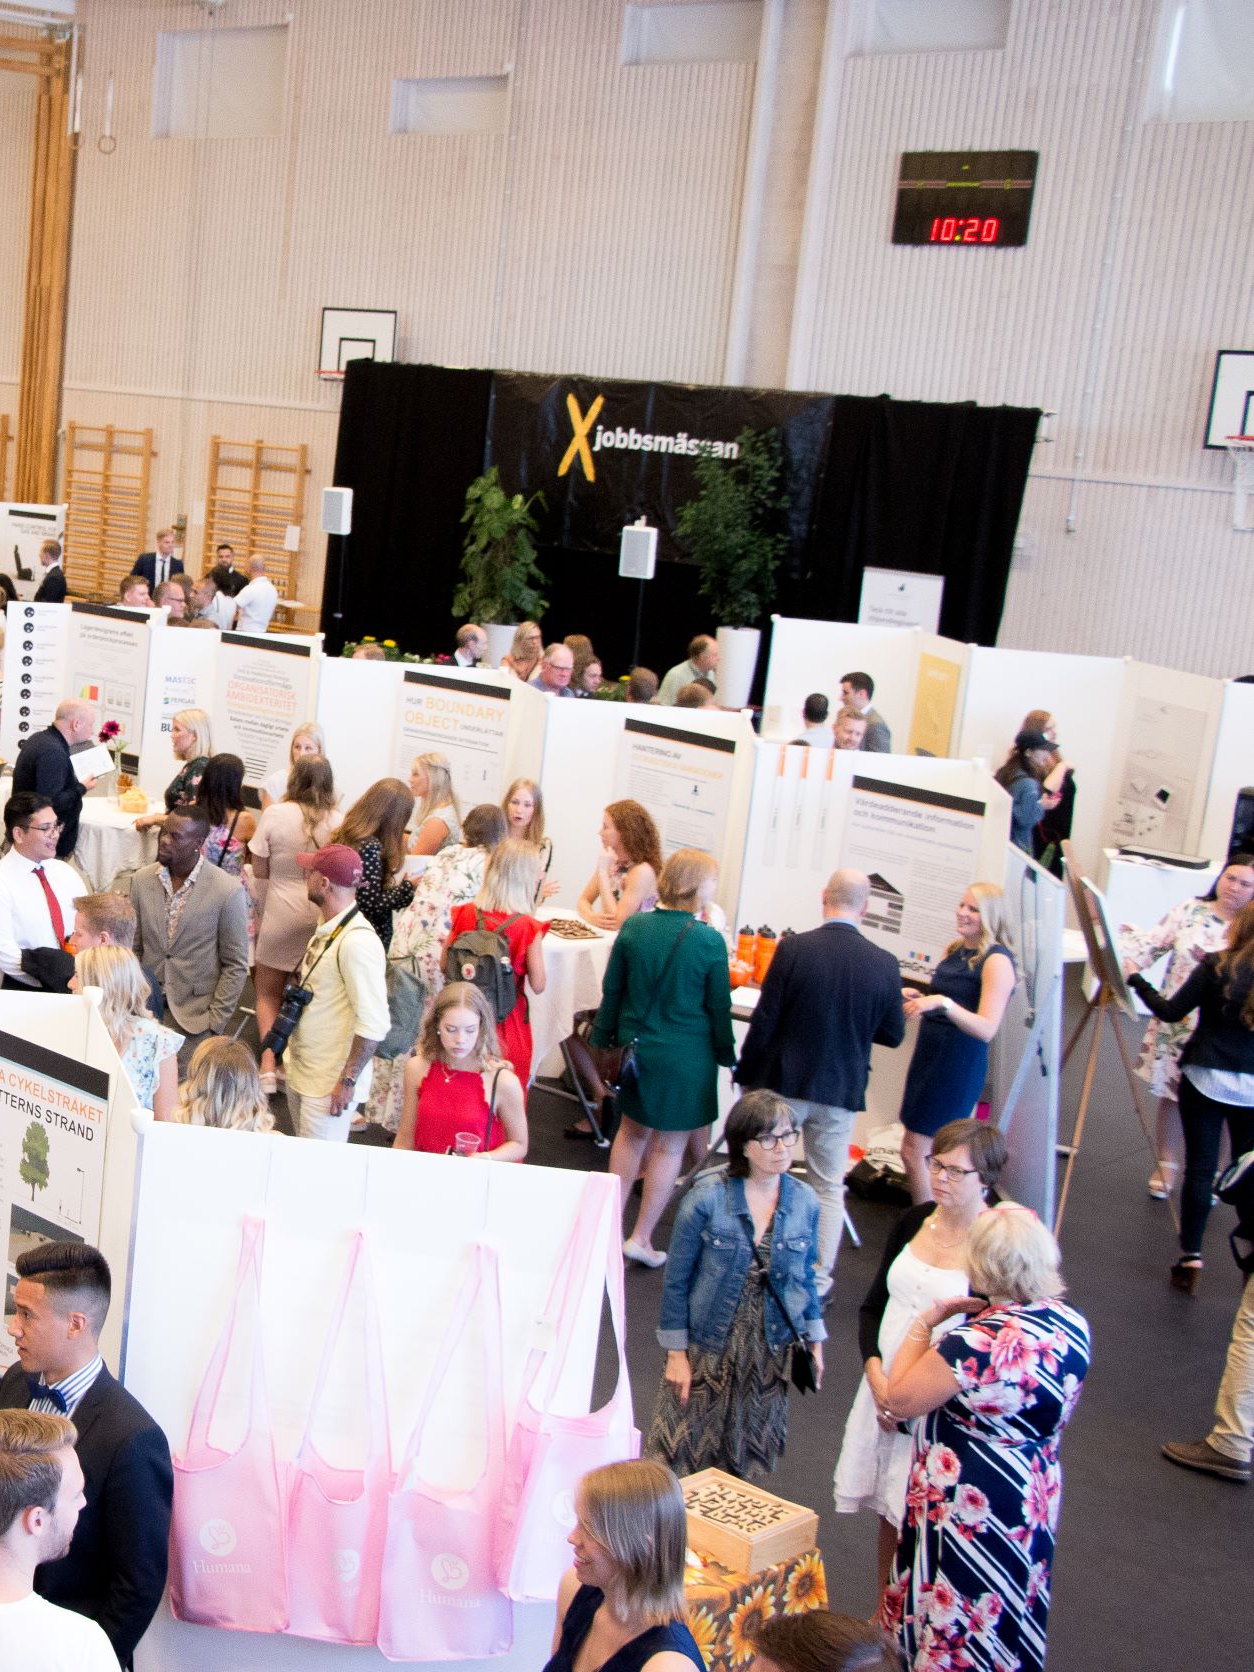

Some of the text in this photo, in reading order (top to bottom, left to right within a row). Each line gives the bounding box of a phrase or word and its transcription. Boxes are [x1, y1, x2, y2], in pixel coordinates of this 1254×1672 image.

[930, 217, 1000, 242] 10:20
[165, 676, 197, 685] MASTEC
[425, 696, 505, 721] BOUNDARY
[404, 710, 459, 731] OBJECT
[9, 1072, 104, 1124] CYKELSTRÅKET
[45, 1109, 94, 1142] STRAND
[193, 1559, 252, 1574] Humana
[420, 1588, 482, 1609] Humana
